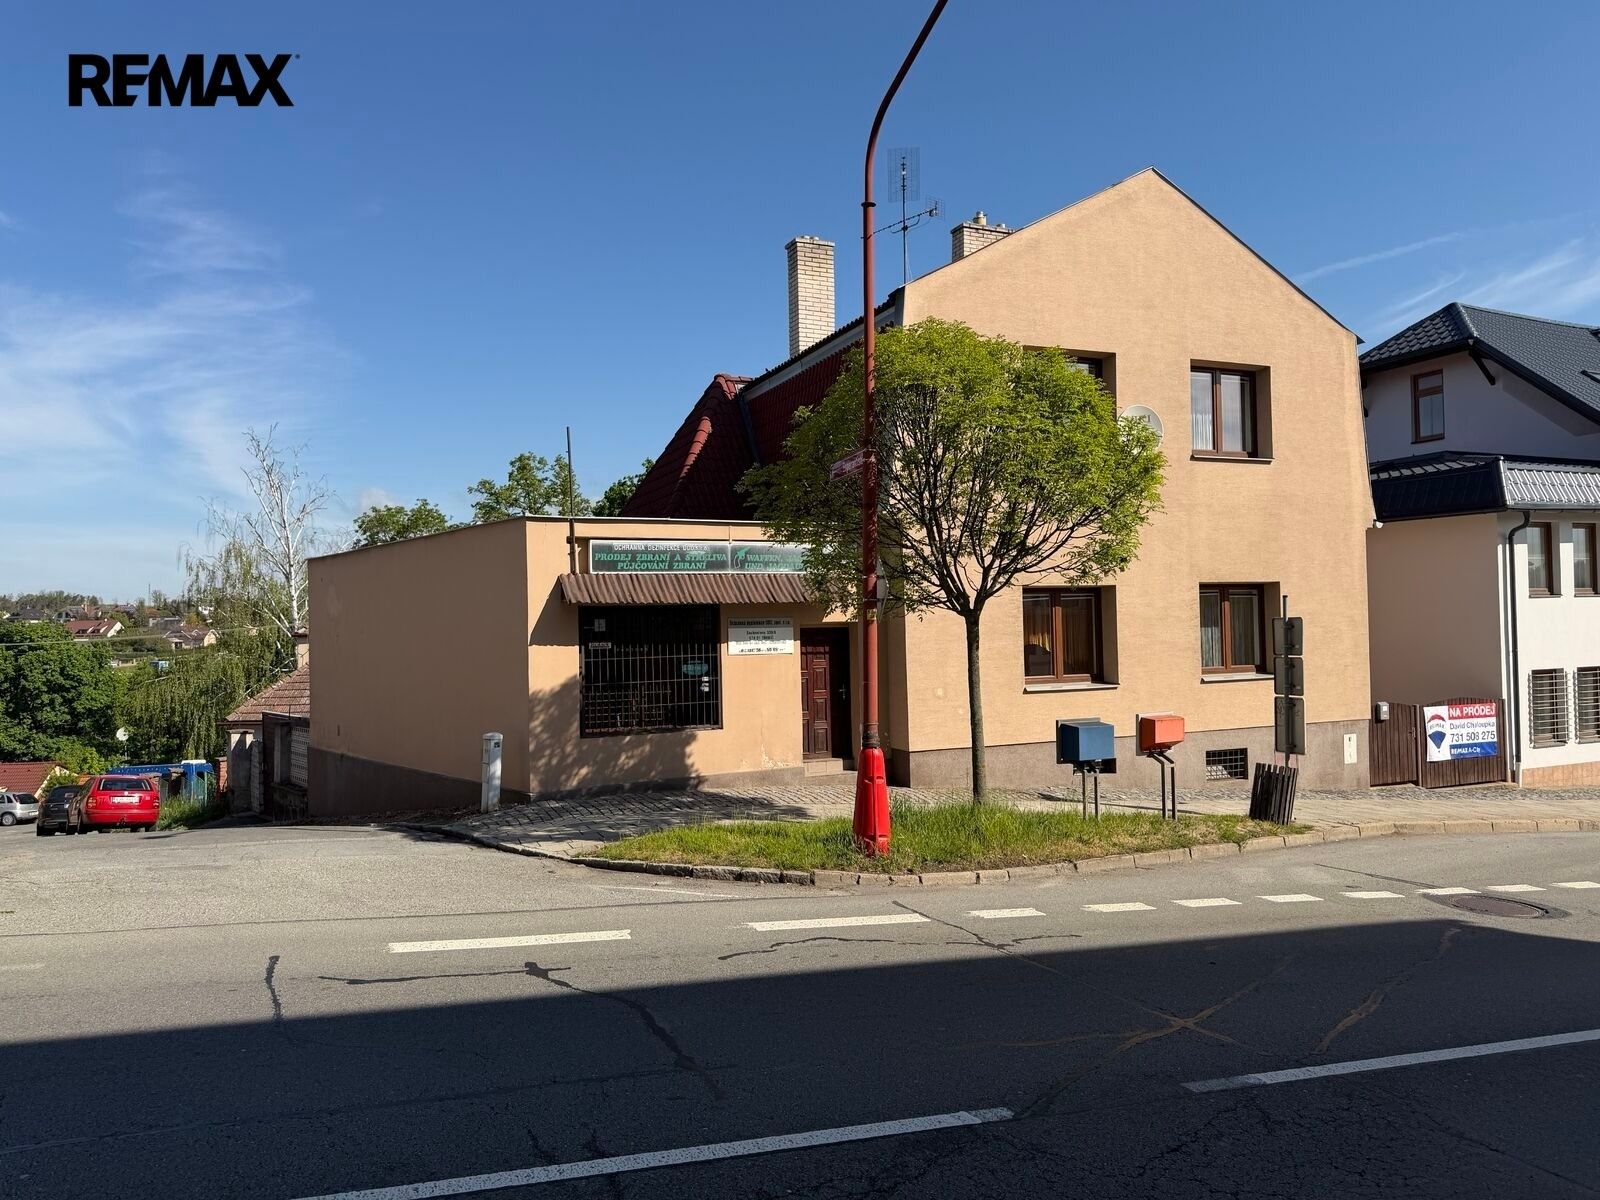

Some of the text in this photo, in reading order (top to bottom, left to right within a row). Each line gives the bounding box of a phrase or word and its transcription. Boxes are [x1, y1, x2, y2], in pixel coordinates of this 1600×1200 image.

[595, 553, 632, 561] PRODEJ
[636, 552, 671, 561] ZBRANÍ
[674, 553, 681, 561] A
[617, 561, 707, 570] PŮJČOVÁNÍ ZBRANÍ
[745, 562, 764, 570] UND
[1449, 705, 1495, 717] NA PRODEJ
[1449, 721, 1495, 730] David Chaloupka
[1450, 733, 1464, 743] 731
[1481, 730, 1496, 740] 275
